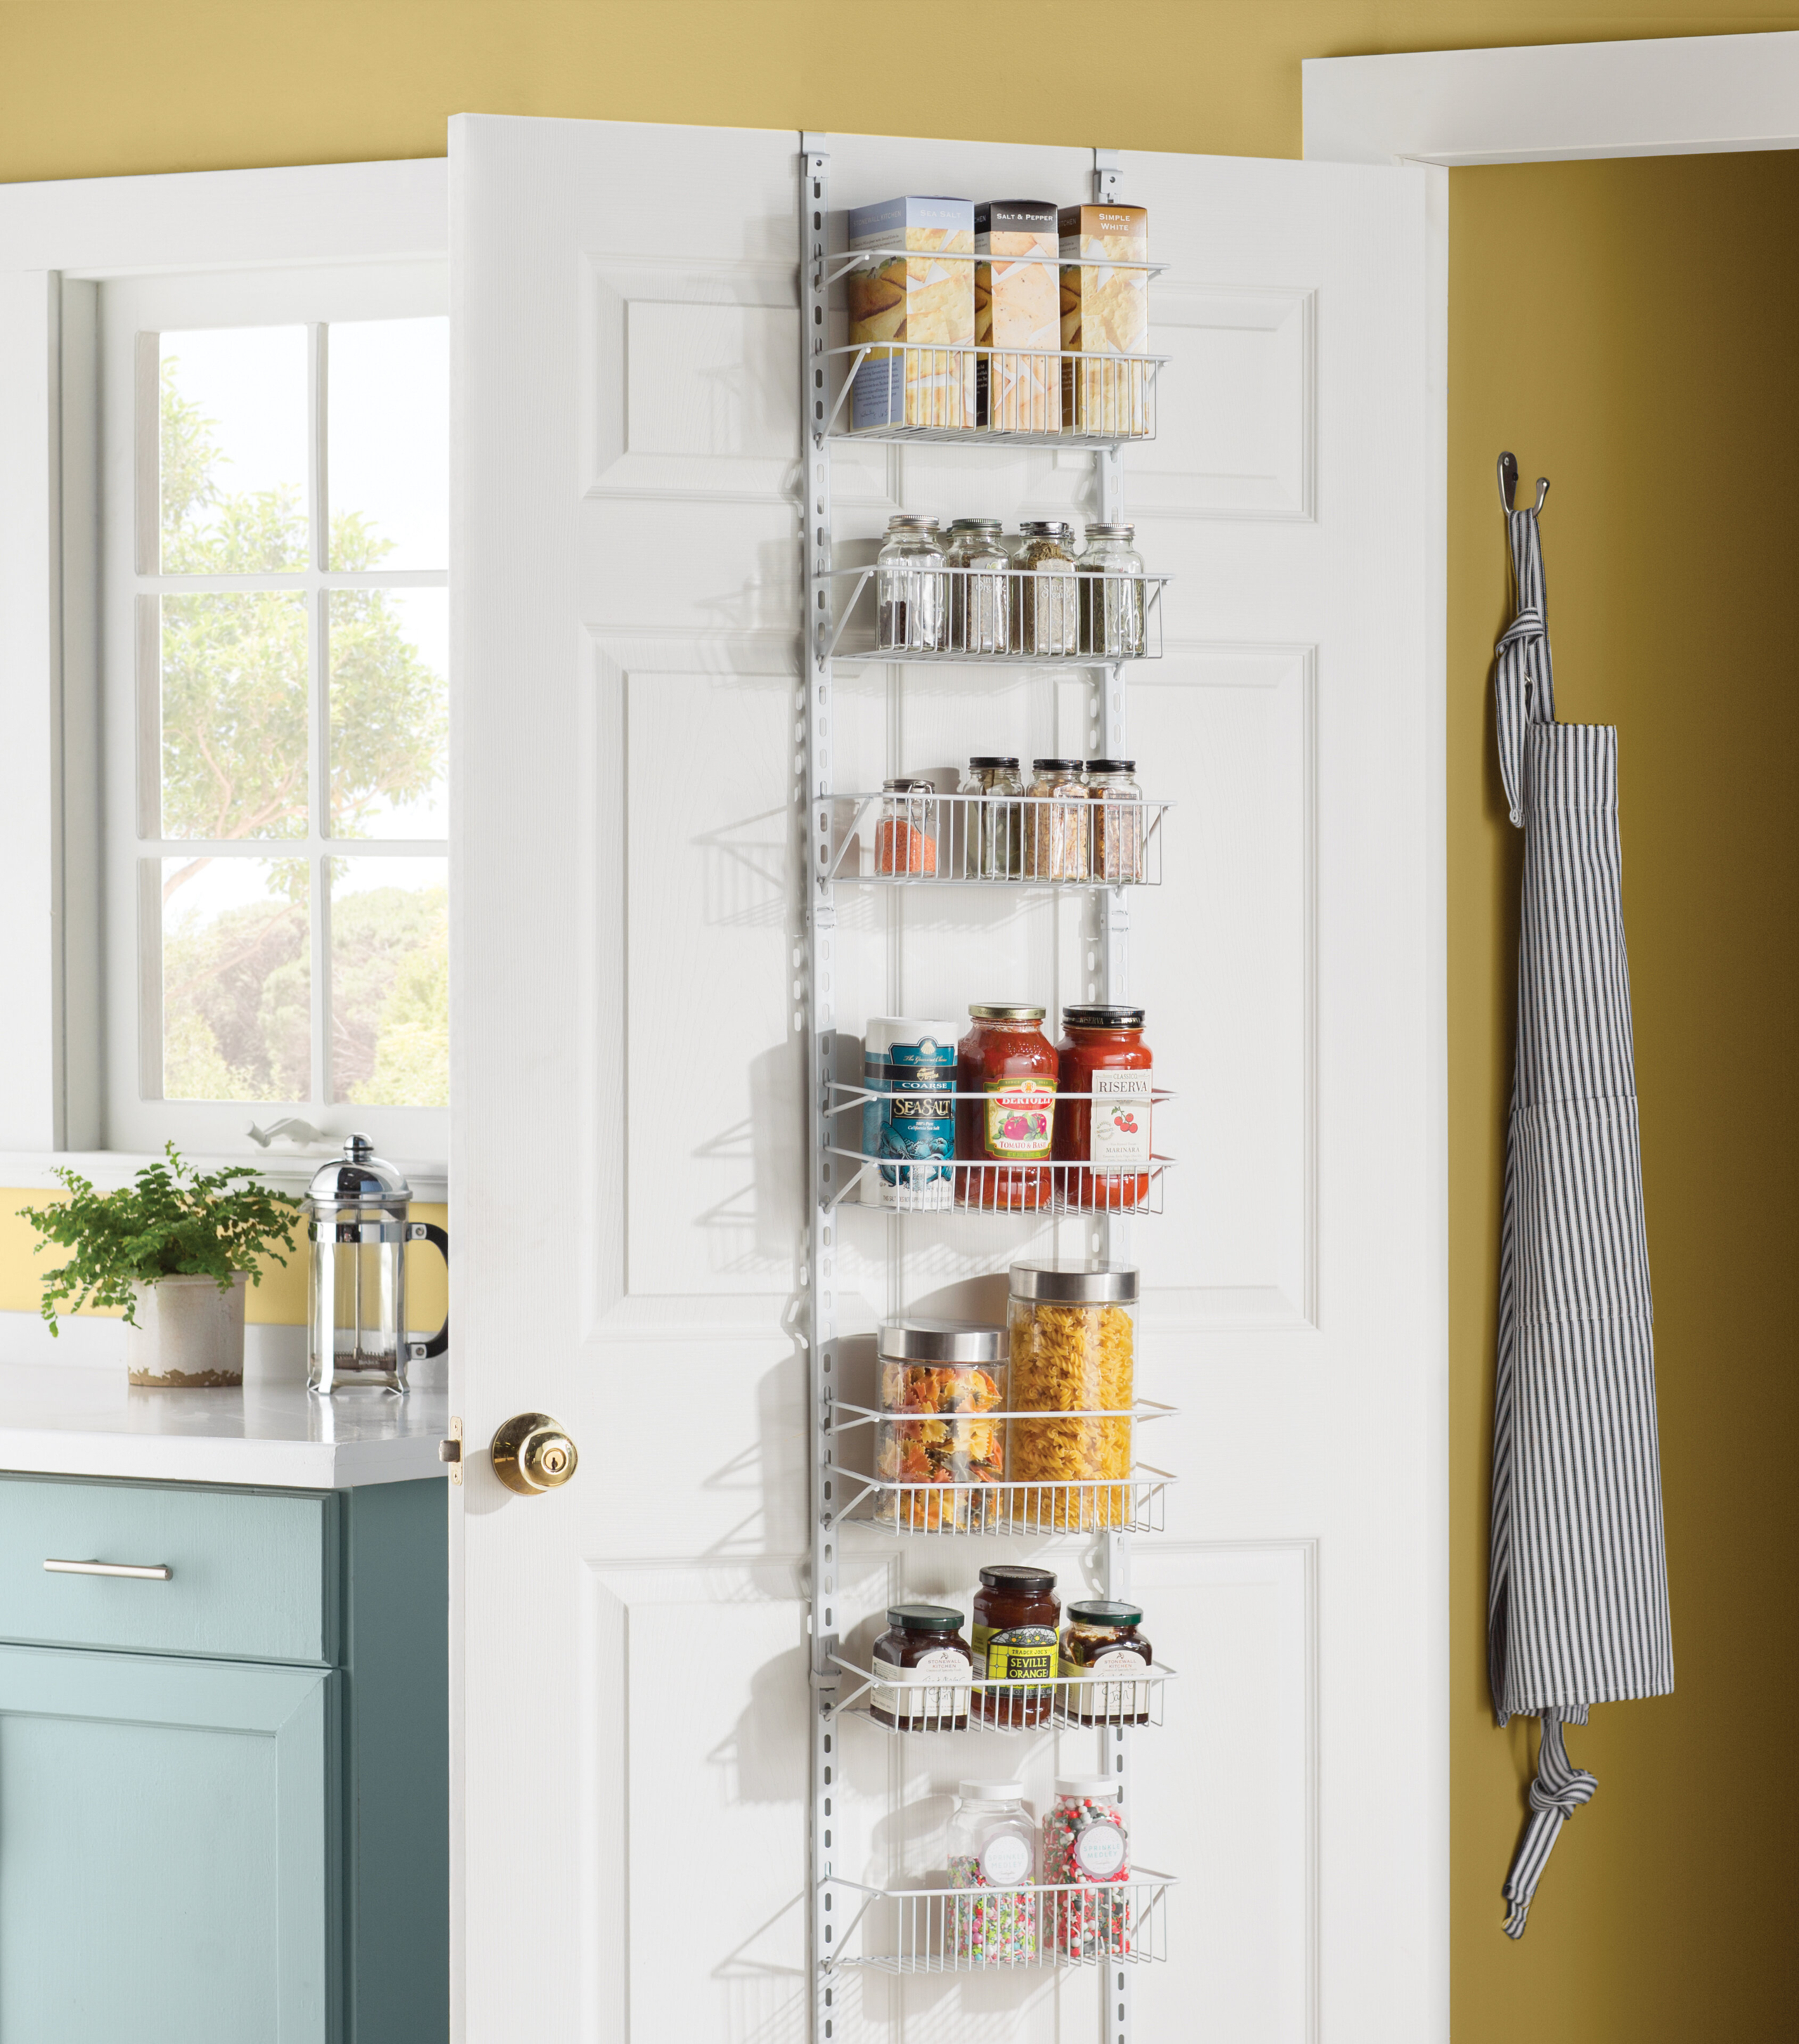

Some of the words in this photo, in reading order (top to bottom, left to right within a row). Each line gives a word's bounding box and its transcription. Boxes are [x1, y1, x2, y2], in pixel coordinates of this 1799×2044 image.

[852, 216, 880, 227] STONEWALL
[881, 211, 902, 221] KITCHEN
[974, 215, 987, 223] CHEN
[1059, 218, 1077, 226] ITCHEN
[1100, 223, 1129, 231] WHITE
[1099, 1081, 1147, 1092] RISERVA
[1011, 1658, 1047, 1667] SEVILLE
[1009, 1669, 1047, 1679] ORANGE
